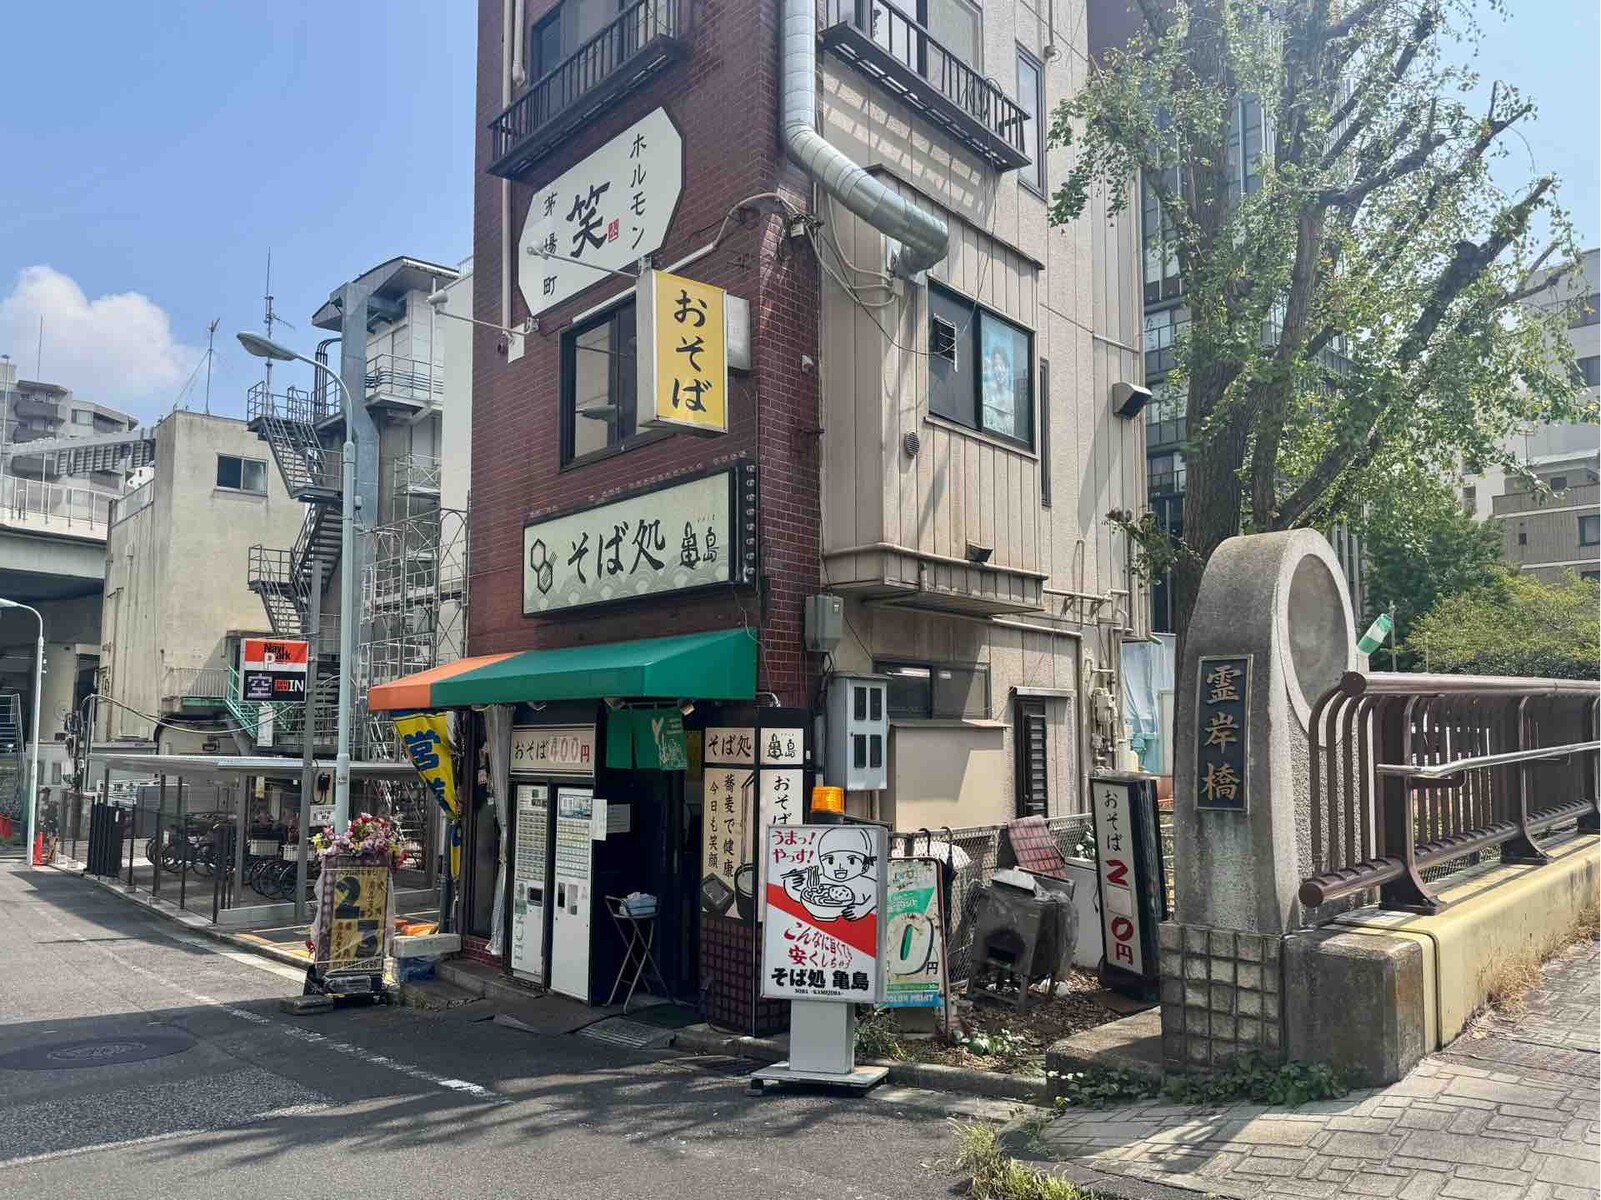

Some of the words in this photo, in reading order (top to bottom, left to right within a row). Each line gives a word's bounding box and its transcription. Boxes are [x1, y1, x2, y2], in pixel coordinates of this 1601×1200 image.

[566, 180, 611, 258] 笑
[629, 133, 647, 249] ホルモン
[543, 192, 558, 296] 茅場町
[671, 289, 713, 413] おそば
[567, 519, 666, 583] そば処
[247, 673, 272, 698] 空
[289, 679, 304, 692] IN
[708, 734, 752, 760] そば処
[1201, 665, 1241, 801] 霊岸橋
[723, 772, 736, 878] 蕎麦で健康
[771, 967, 826, 989] そば処
[832, 970, 870, 991] 亀島
